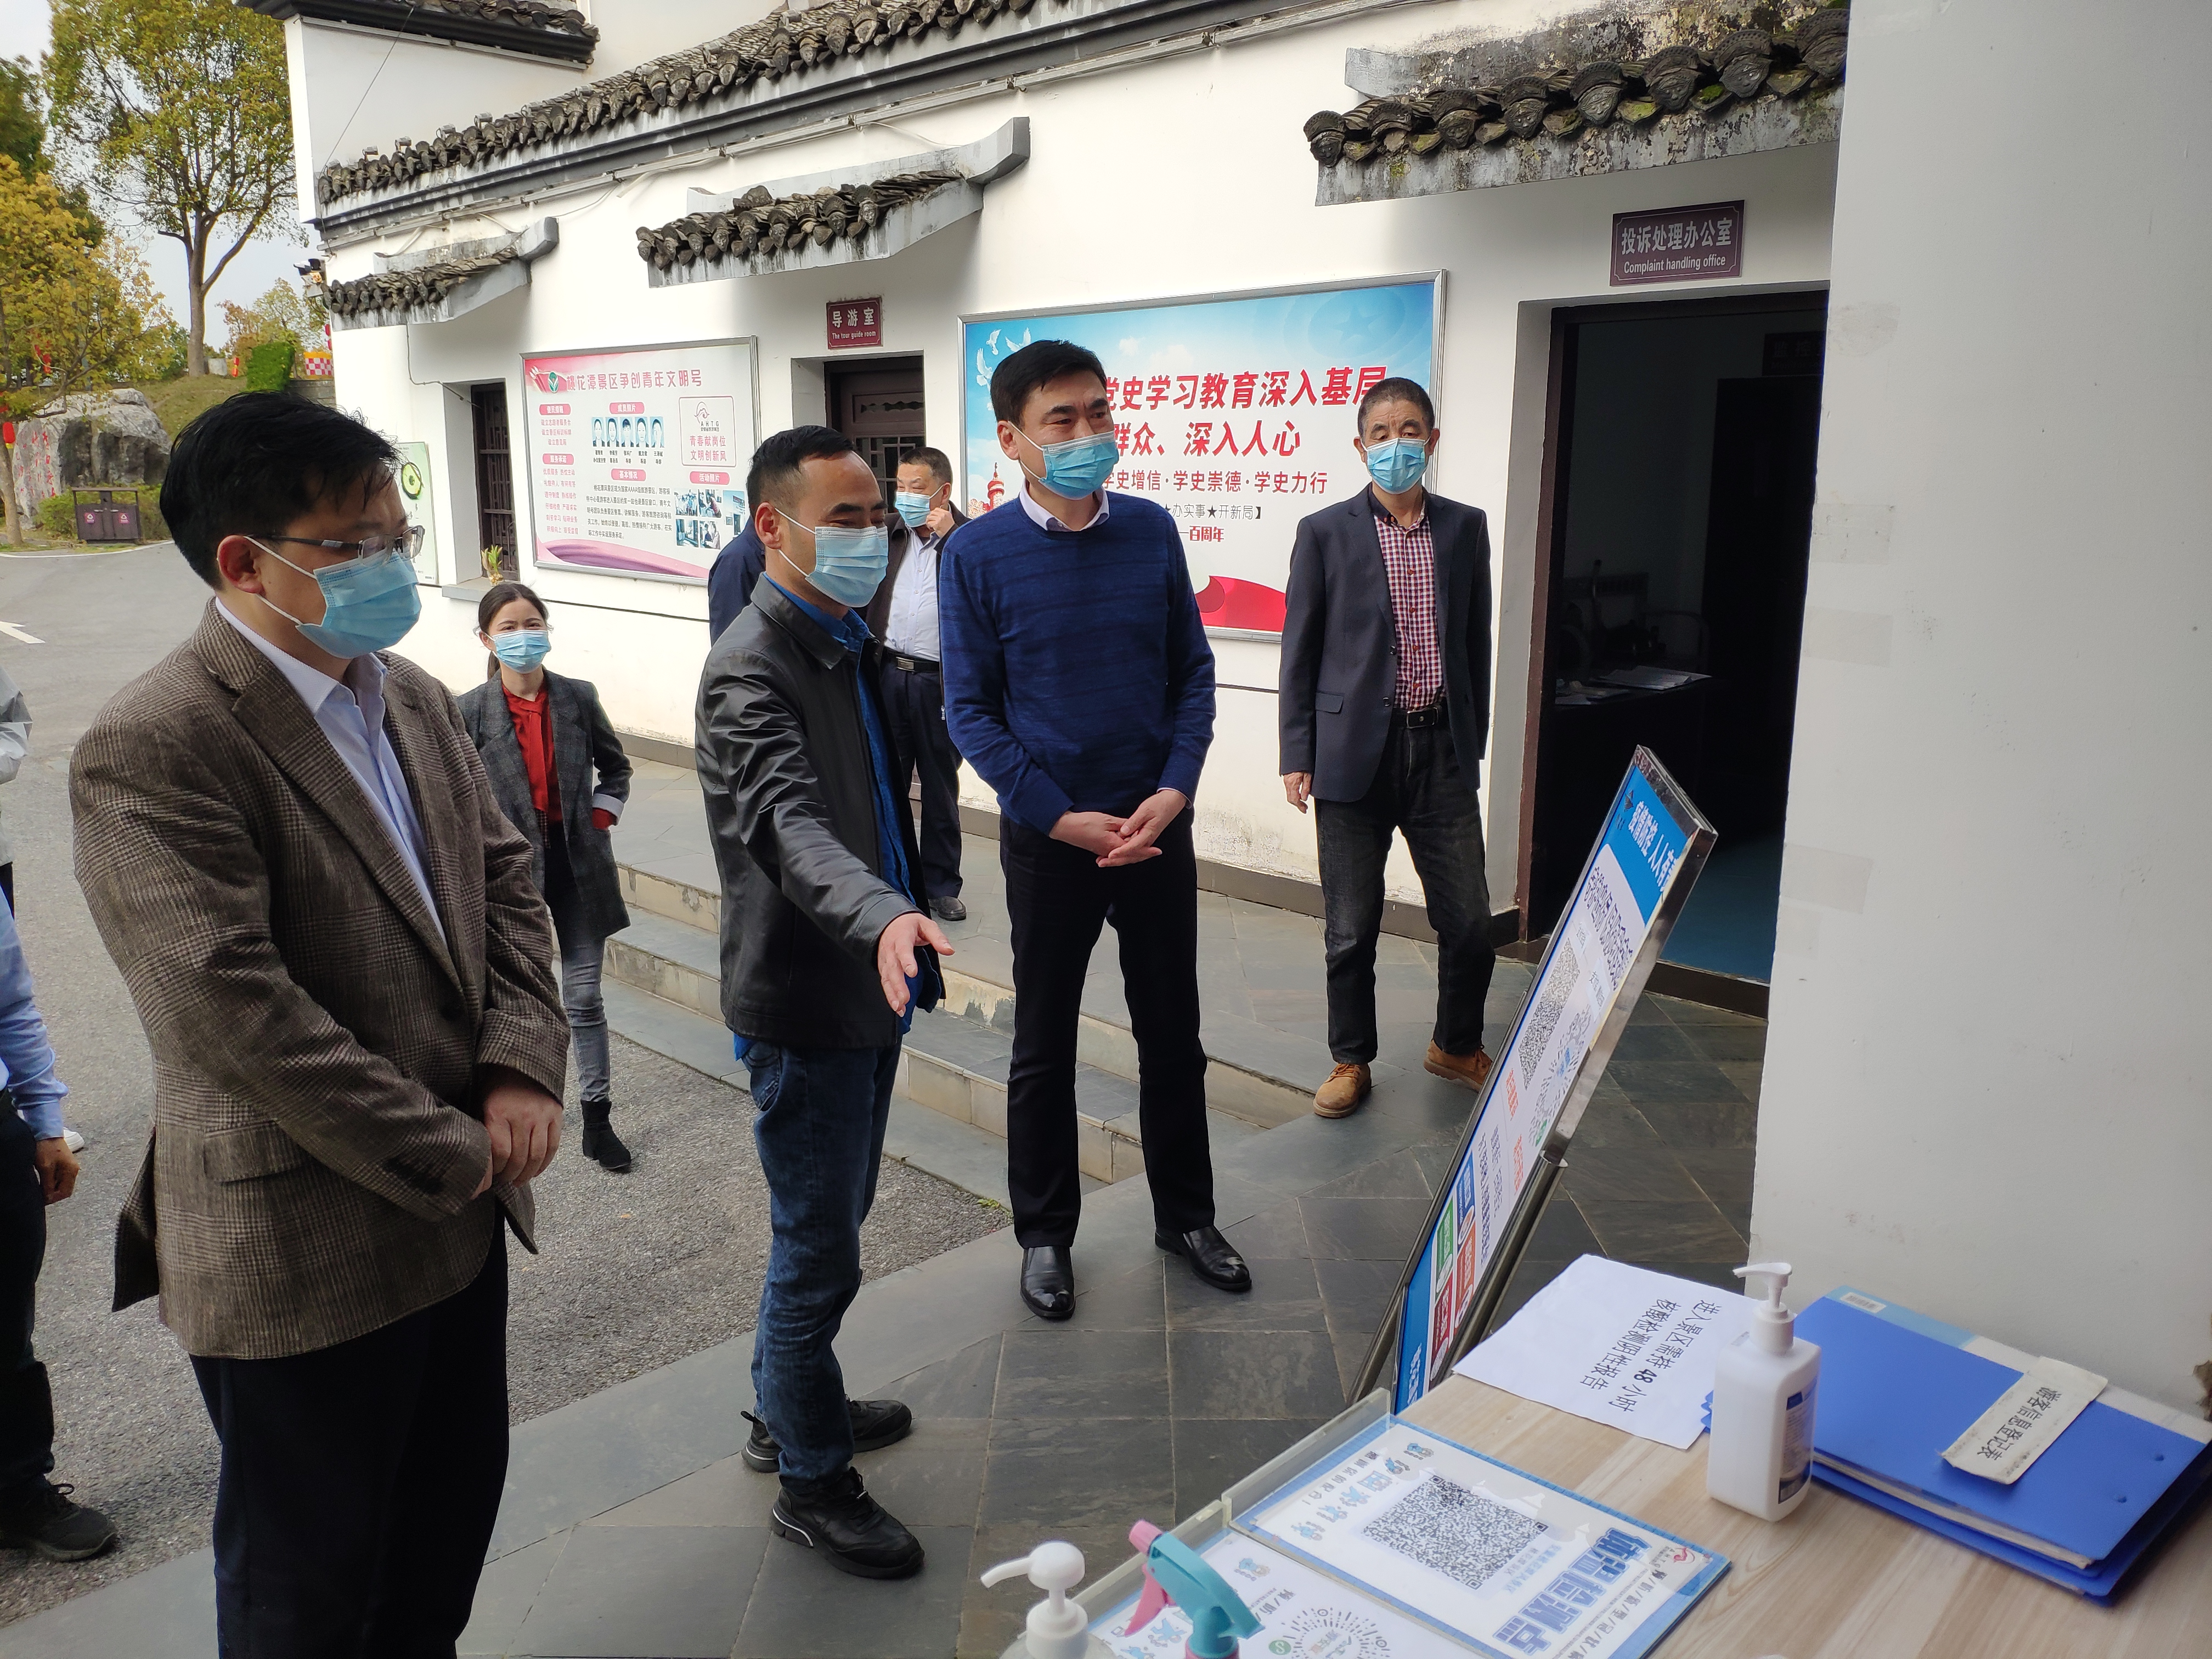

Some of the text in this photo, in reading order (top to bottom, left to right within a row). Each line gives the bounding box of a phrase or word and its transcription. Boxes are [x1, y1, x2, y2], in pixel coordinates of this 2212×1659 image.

[1622, 217, 1732, 255] 投诉处理办公室
[1624, 254, 1726, 275] Complaint handling office
[832, 307, 874, 328] 导游室
[851, 331, 863, 339] guide
[567, 369, 702, 391] 桃花潭景区争创青年文明号
[690, 436, 726, 447] 青春献岗位
[690, 450, 727, 461] 文明创新风
[619, 471, 638, 479] 基本情况
[699, 473, 720, 482] 活动照片
[1178, 526, 1224, 542] 一百周年
[1628, 800, 1660, 857] 疫情防控
[1584, 866, 1613, 934] 守护出行
[1505, 1068, 1519, 1121] 请扫健康码
[1491, 1124, 1503, 1218] 健康通行 扫码登记
[1513, 1133, 1524, 1195] 请扫行程码
[1580, 1299, 1681, 1390] 核酸检测阴性报告
[1609, 1300, 1722, 1412] 进入景区需持 48 小时
[1977, 1387, 2062, 1460] 游客信息登记表
[1492, 1527, 1652, 1656] 体温检测点
